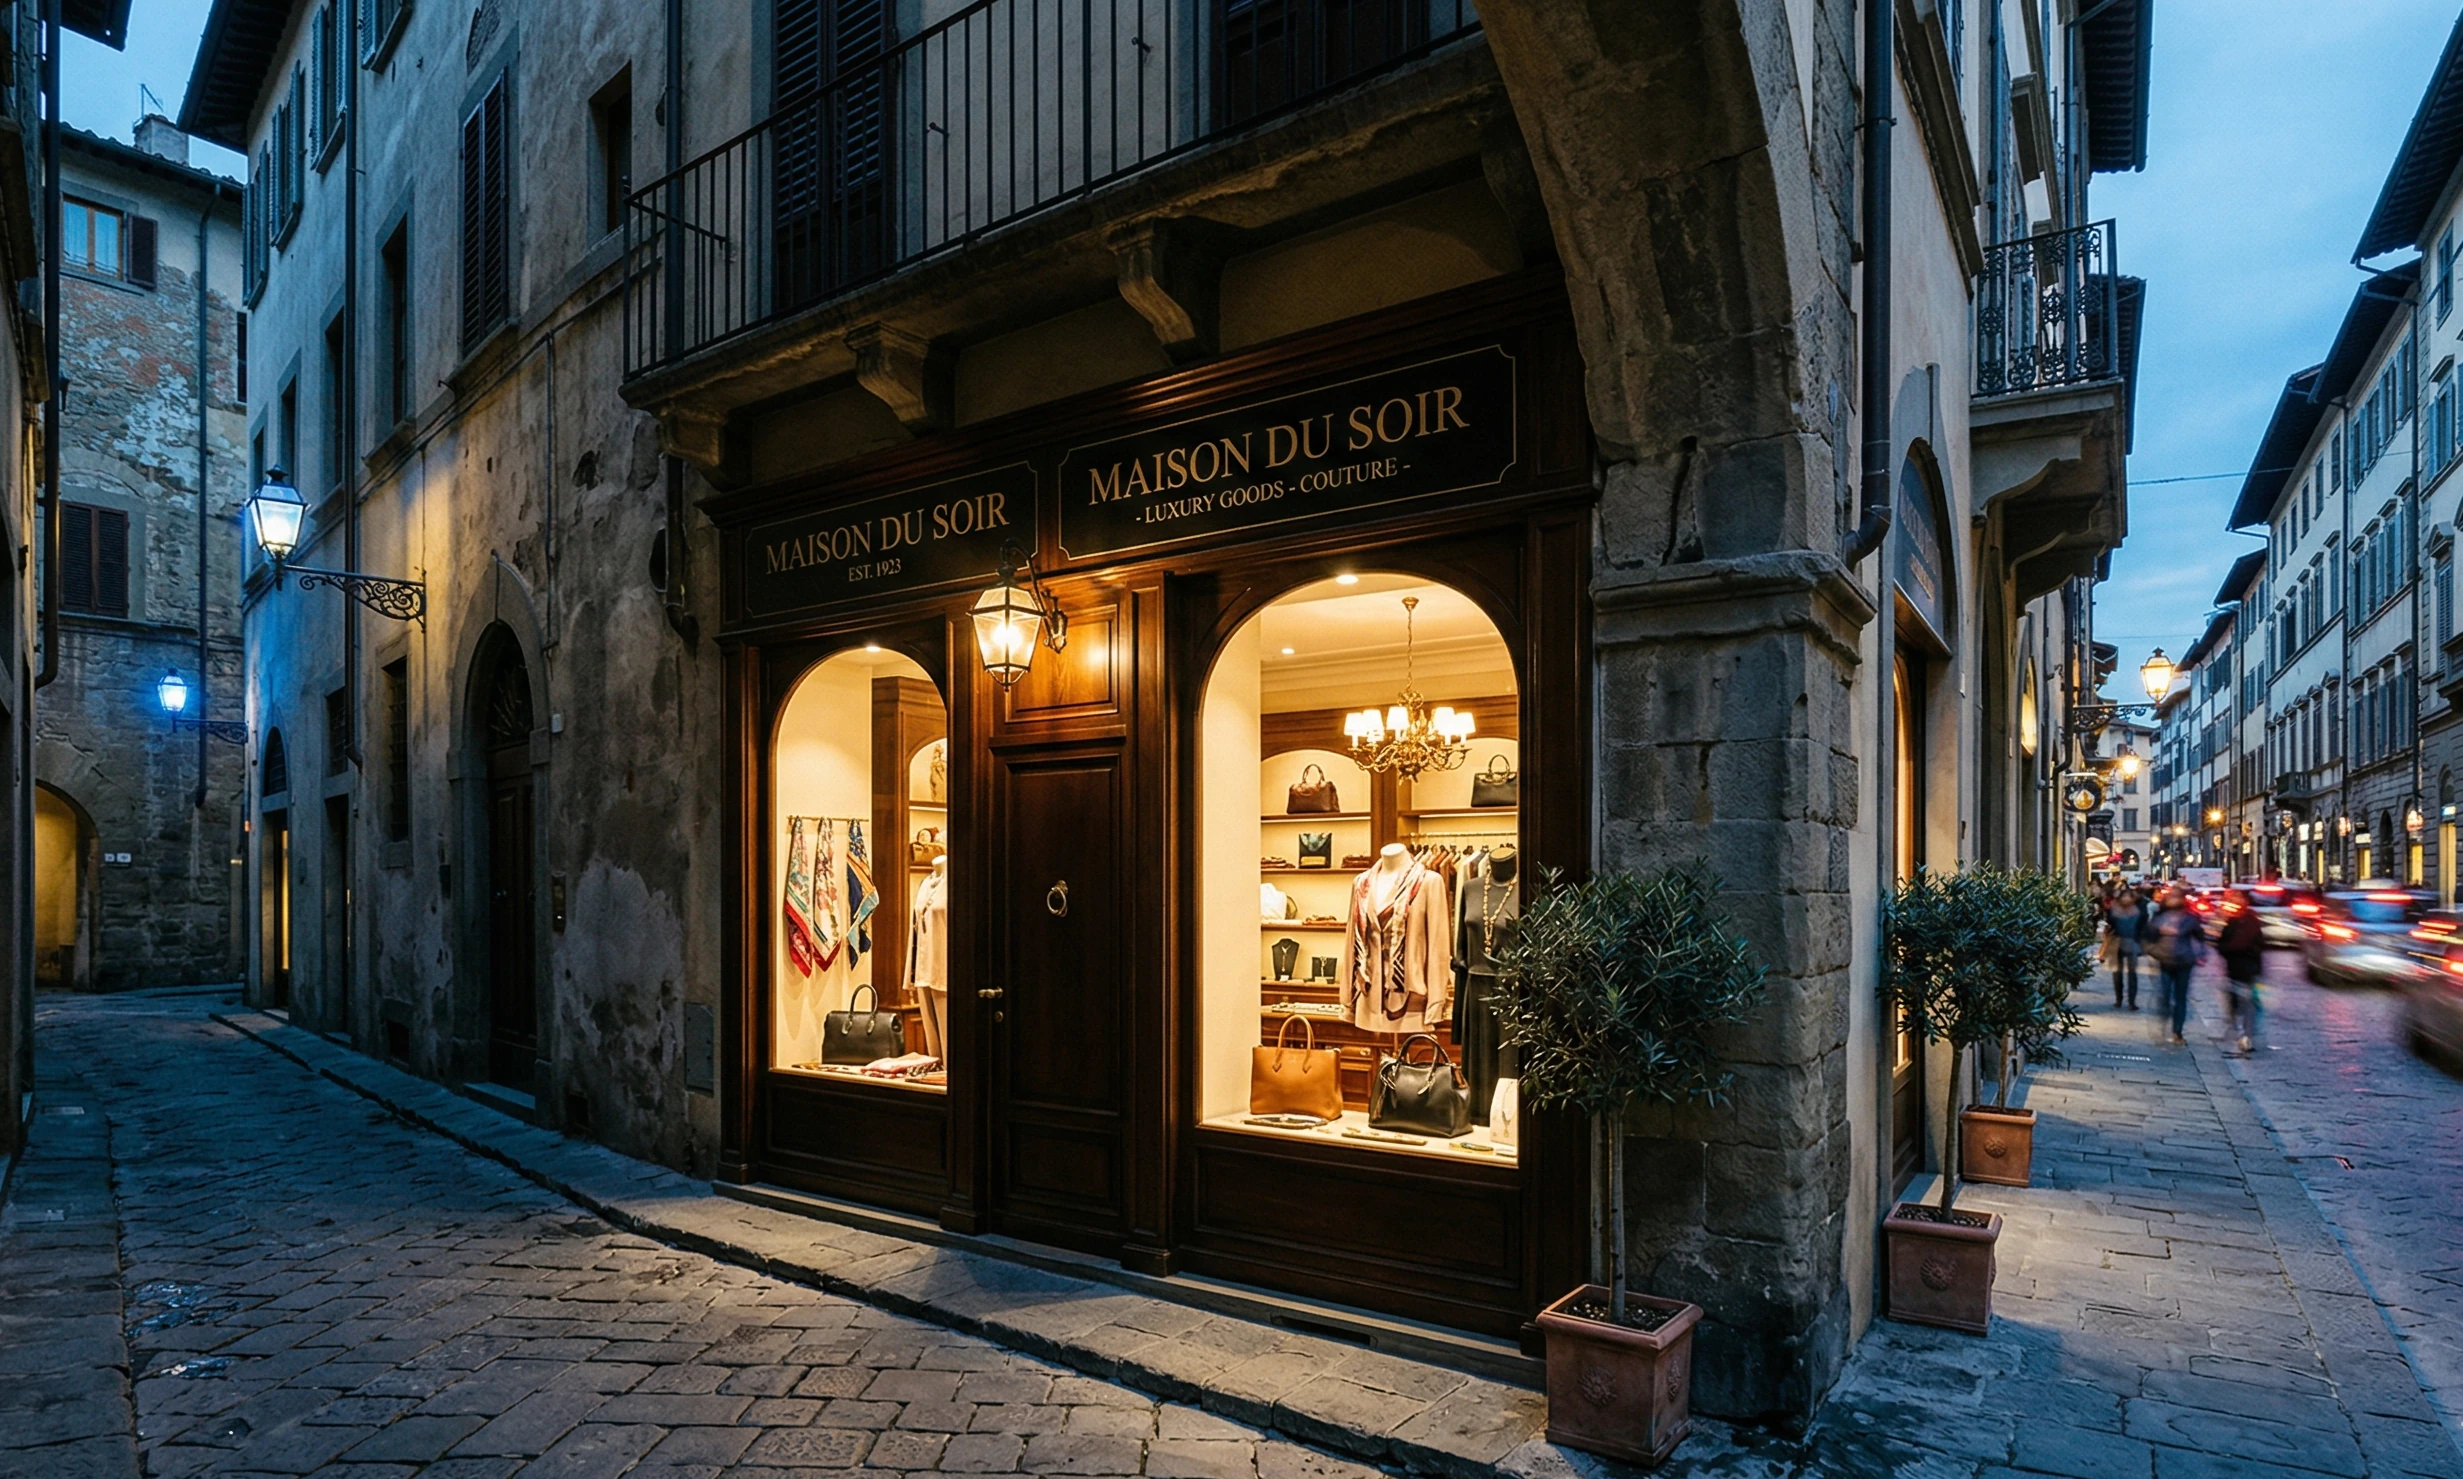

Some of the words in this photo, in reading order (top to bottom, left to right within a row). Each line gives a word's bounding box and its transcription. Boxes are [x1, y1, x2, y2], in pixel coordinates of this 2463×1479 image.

[1088, 432, 1253, 506] MAISON
[1265, 413, 1334, 469] DU
[1349, 386, 1470, 451] SOIR
[1145, 493, 1216, 524] LUXURY
[1219, 480, 1285, 509] GOODS
[1300, 457, 1398, 493] COUTURE
[766, 521, 873, 575] MAISON
[880, 508, 926, 551] DU
[932, 492, 1010, 540] SOIR
[848, 564, 873, 582] EST.
[876, 558, 901, 577] 1923
